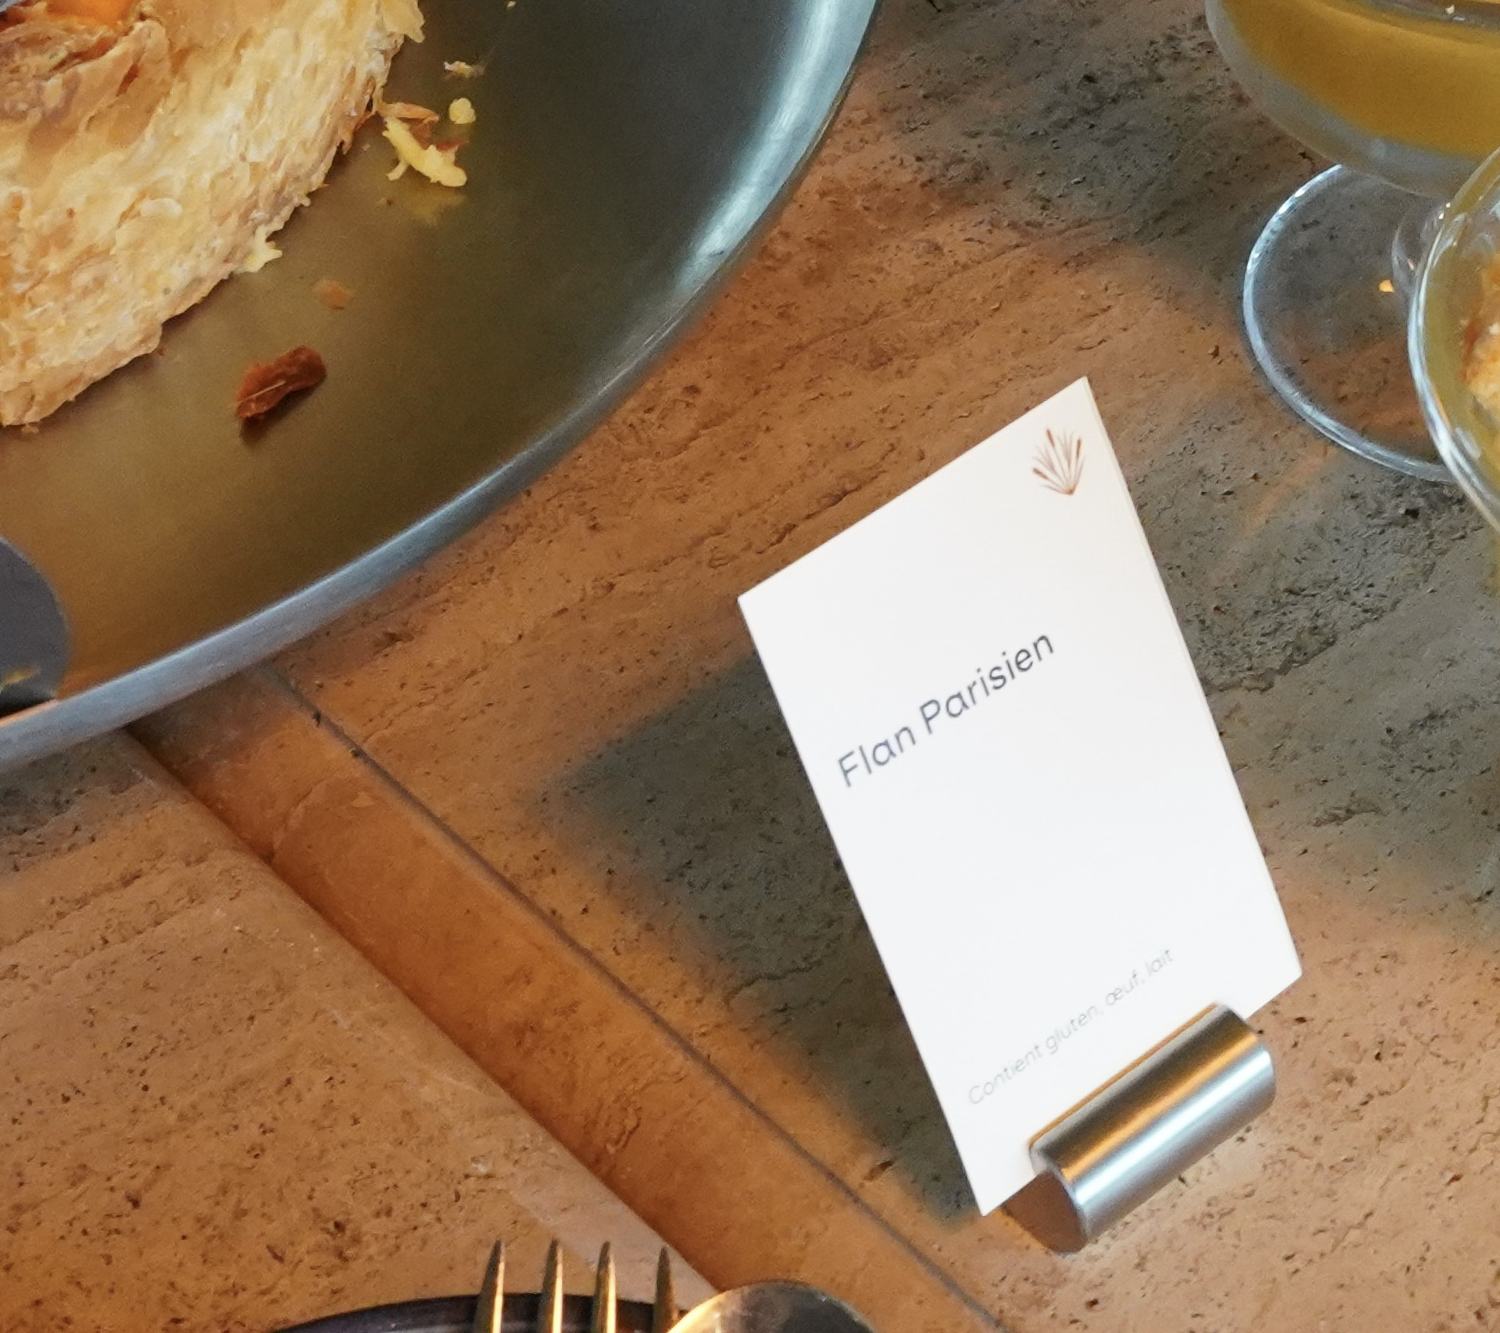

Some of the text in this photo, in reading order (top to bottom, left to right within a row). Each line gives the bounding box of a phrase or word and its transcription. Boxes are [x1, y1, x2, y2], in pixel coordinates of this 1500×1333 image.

[837, 634, 1055, 788] Flan Parisien
[967, 1044, 1042, 1105] Contient
[1045, 1004, 1103, 1055] gluten,
[1145, 948, 1173, 976] lait
